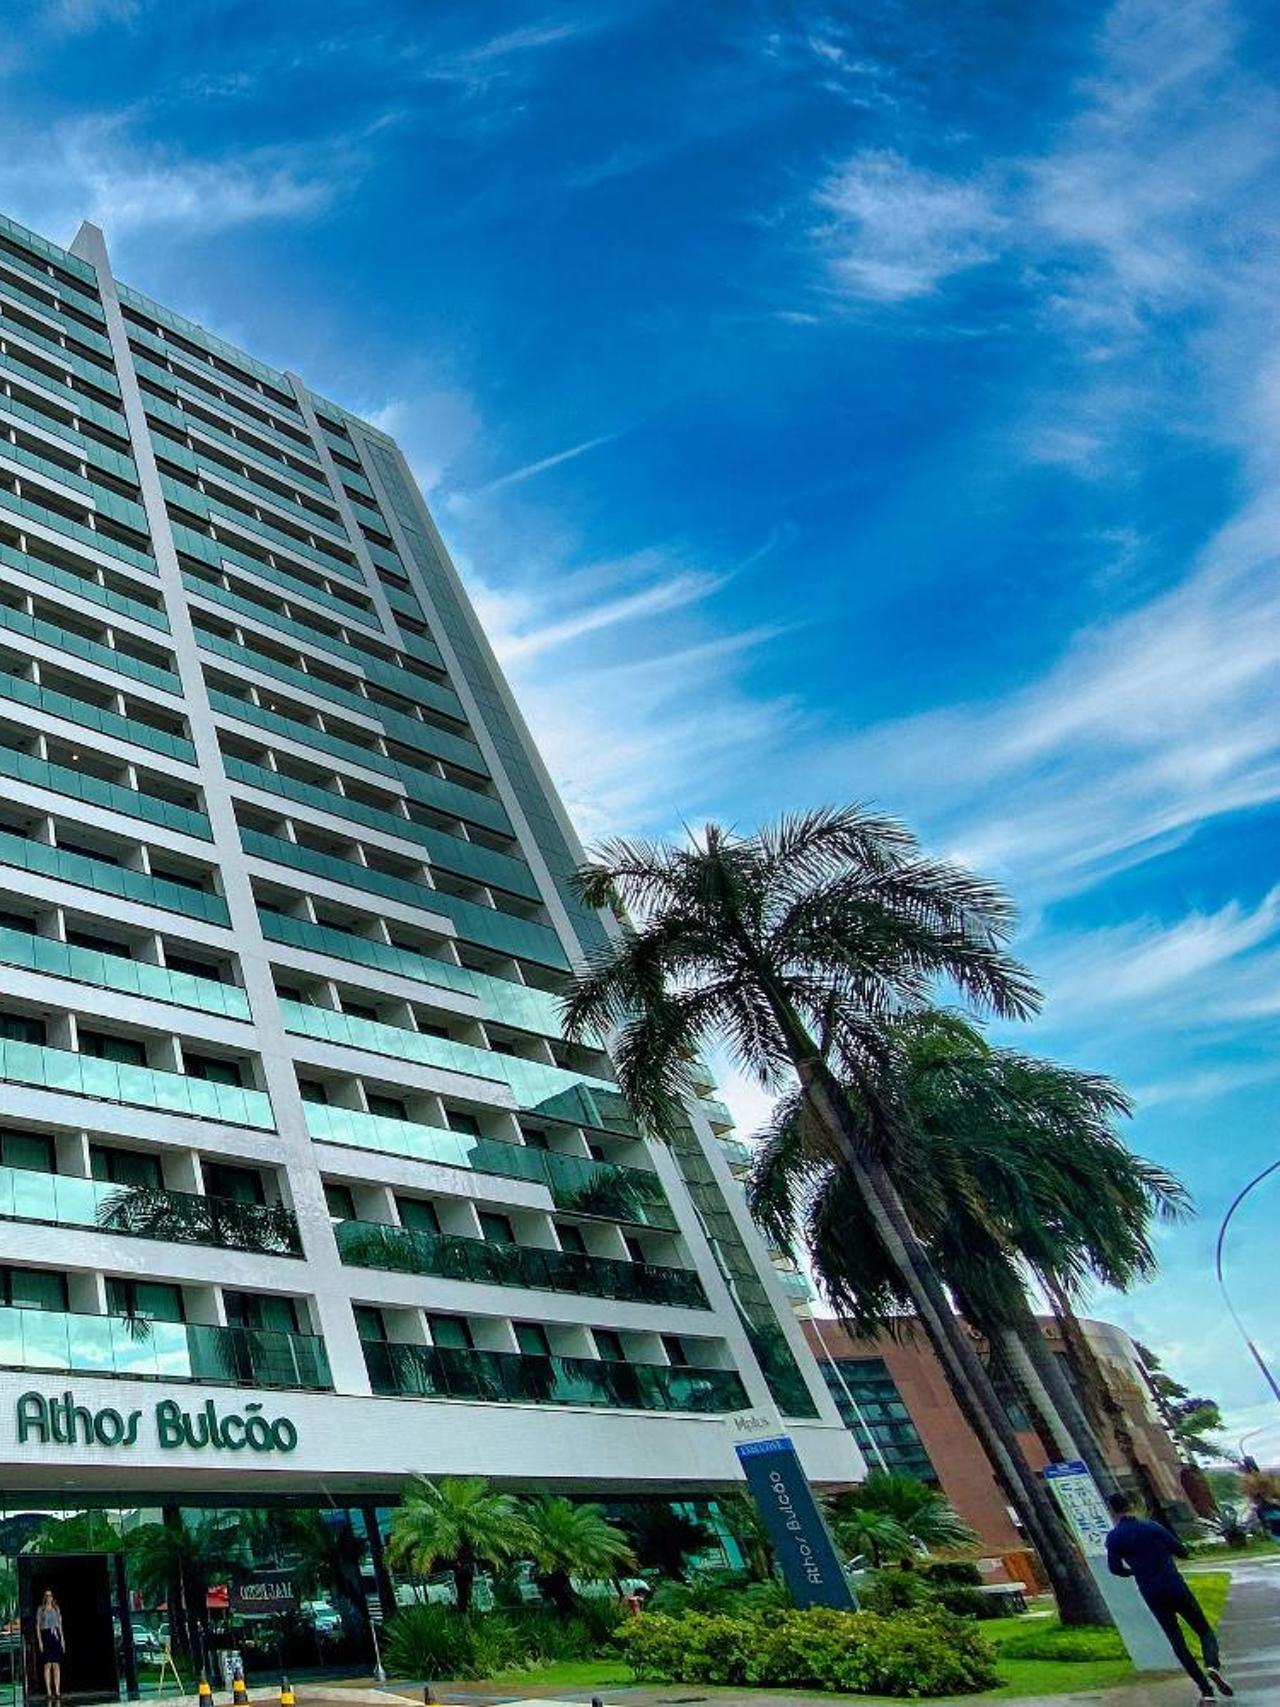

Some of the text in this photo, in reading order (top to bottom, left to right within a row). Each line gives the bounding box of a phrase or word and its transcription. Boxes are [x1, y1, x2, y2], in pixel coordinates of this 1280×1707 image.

[16, 1391, 298, 1452] Athos Bulcão
[769, 1471, 823, 1584] Athos Bulcão
